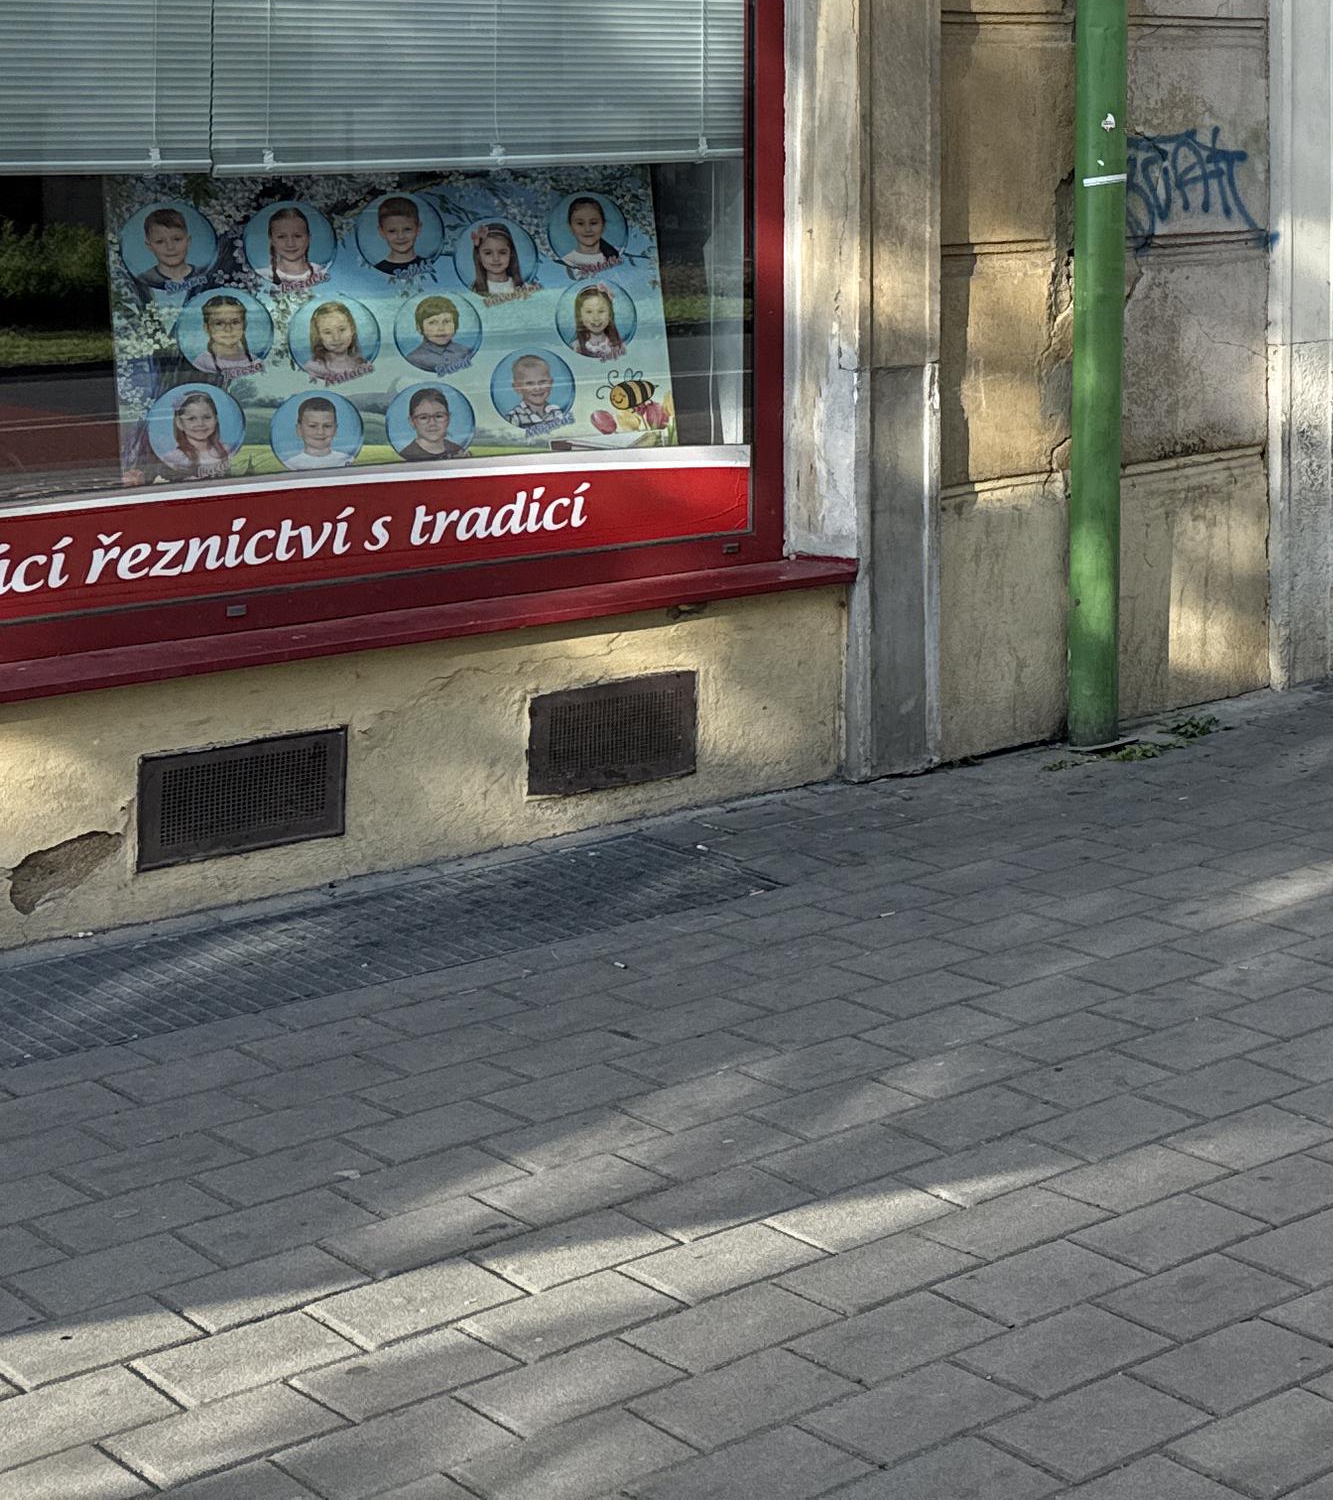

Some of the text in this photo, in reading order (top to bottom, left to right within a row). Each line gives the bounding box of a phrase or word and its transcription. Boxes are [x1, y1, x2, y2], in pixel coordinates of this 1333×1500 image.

[85, 506, 355, 585] řeznictví
[364, 515, 392, 551] s
[409, 482, 591, 545] tradicí
